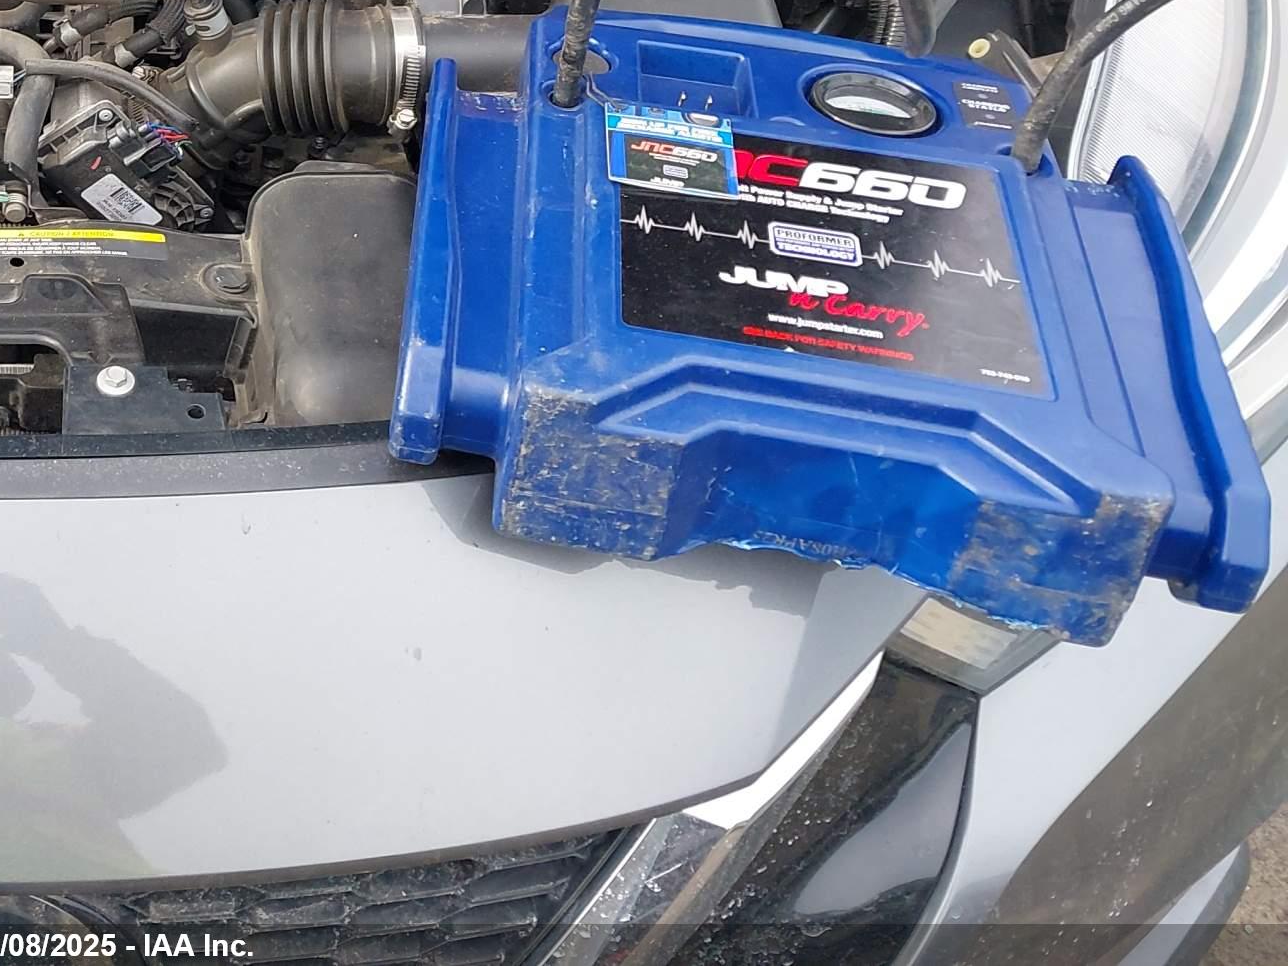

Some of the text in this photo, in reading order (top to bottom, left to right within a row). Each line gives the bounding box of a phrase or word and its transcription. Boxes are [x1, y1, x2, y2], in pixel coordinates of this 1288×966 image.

[631, 140, 718, 163] JNC660
[734, 148, 967, 210] C660
[750, 185, 785, 199] Power
[757, 196, 785, 208] AUTO
[776, 229, 852, 247] PROFORMER
[776, 242, 856, 261] TECHNOLOGY
[718, 265, 849, 298] JUMP
